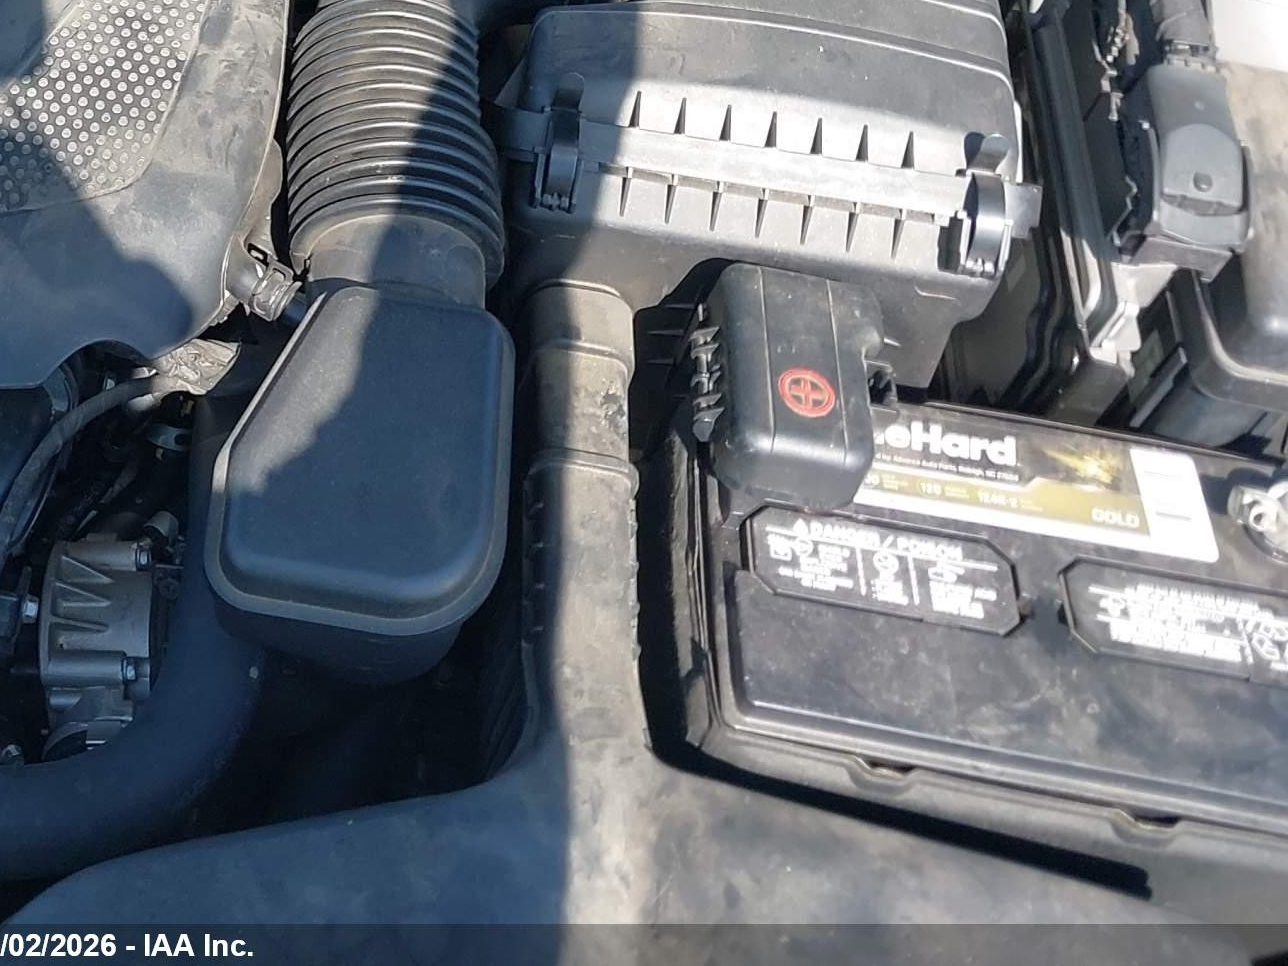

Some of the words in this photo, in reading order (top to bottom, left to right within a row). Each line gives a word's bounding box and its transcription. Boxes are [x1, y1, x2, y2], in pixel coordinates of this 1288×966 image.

[1092, 507, 1139, 528] GOLD
[810, 521, 880, 548] DANGER
[897, 537, 963, 561] POISON
